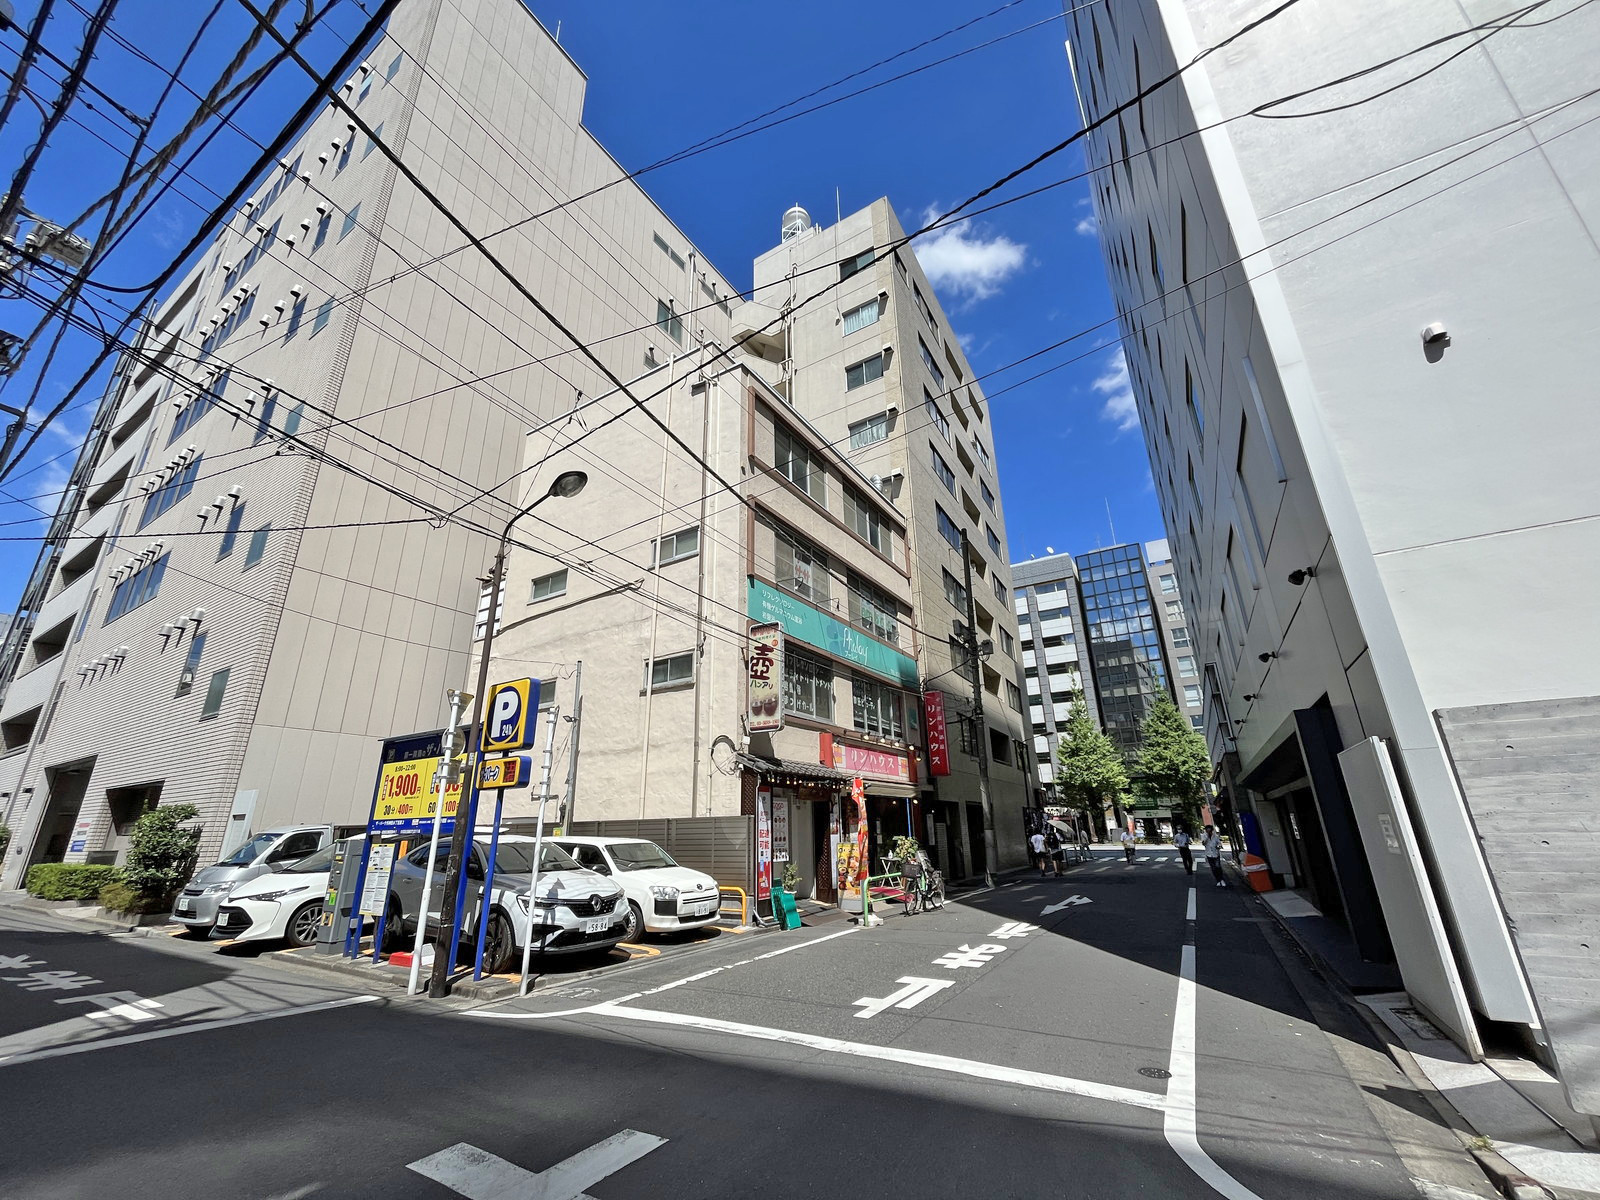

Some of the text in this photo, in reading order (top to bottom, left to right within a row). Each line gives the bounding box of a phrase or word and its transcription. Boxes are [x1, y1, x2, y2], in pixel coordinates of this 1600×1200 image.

[749, 679, 774, 690] ハンアリ
[491, 690, 519, 738] P
[501, 723, 513, 737] 24h
[927, 704, 941, 765] リンハウス
[851, 749, 895, 769] リンハウス
[388, 772, 421, 799] 1,900円
[427, 801, 437, 813] 60
